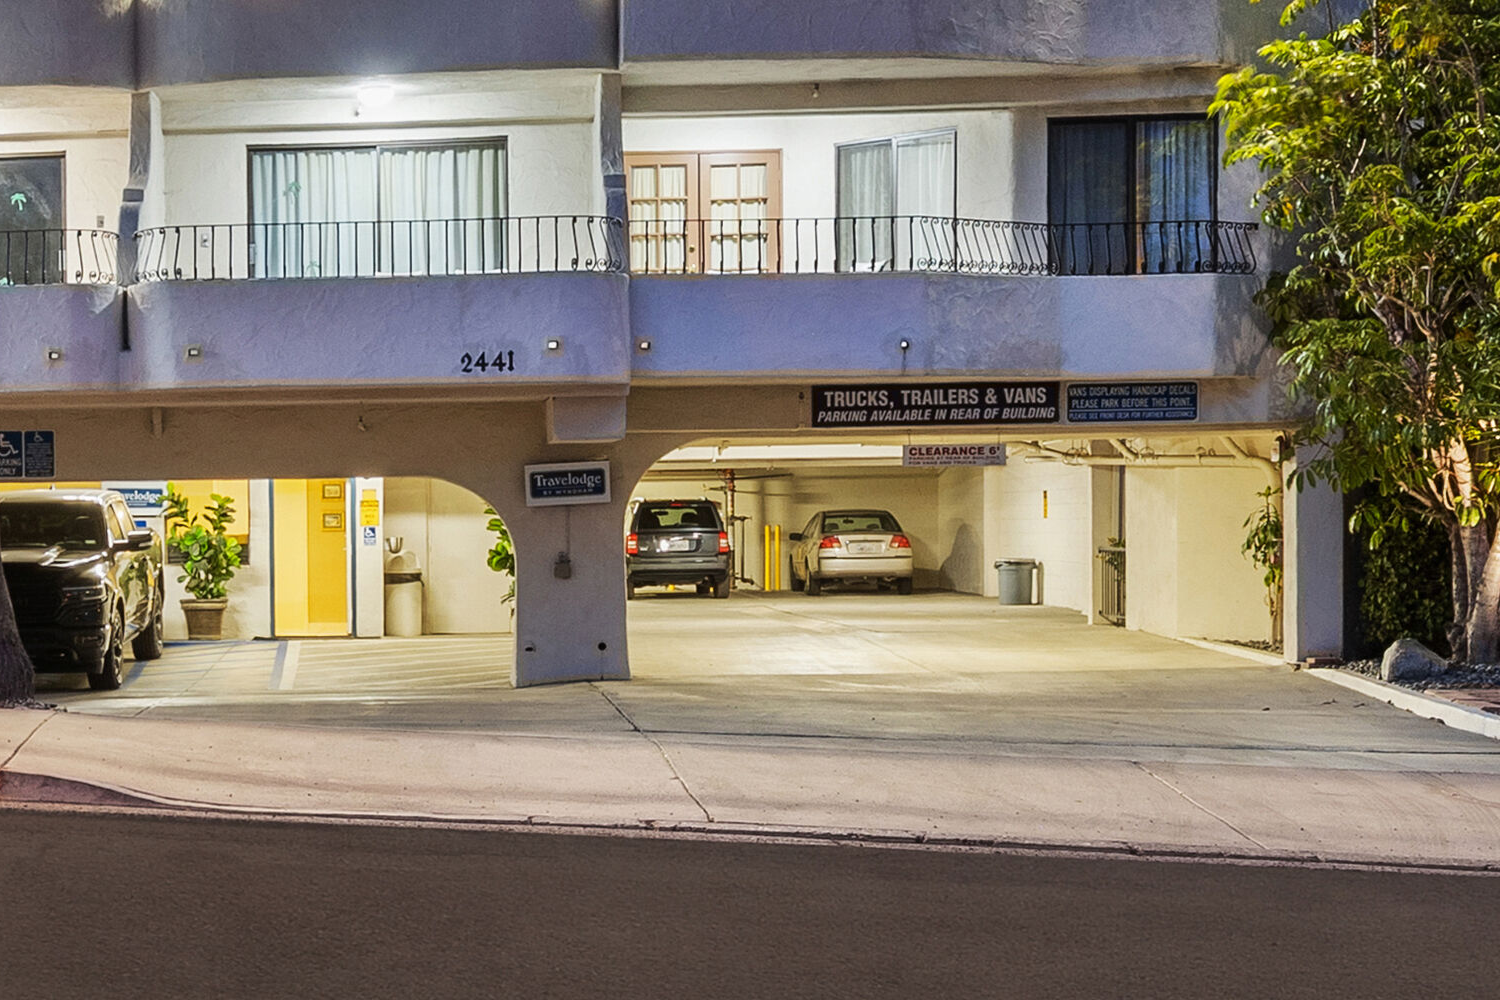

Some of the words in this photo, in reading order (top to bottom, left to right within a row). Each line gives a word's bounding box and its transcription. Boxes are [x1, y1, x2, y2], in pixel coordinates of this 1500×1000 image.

[461, 350, 514, 373] 2441
[824, 390, 894, 409] TRUCKS,
[901, 388, 979, 406] TRAILERS
[985, 388, 998, 405] &
[1004, 387, 1047, 404] VANS
[1069, 387, 1087, 396] VANS
[1089, 386, 1130, 396] DISPLAYING
[1132, 385, 1166, 395] HANDICAP
[1169, 385, 1196, 395] DECALS
[1071, 399, 1098, 408] PLEASE
[1101, 398, 1119, 408] PARK
[1121, 398, 1148, 407] BEFORE
[1152, 397, 1167, 407] THIS
[817, 409, 867, 422] PARKING
[870, 408, 931, 422] AVAILABLE
[935, 408, 947, 420] IN
[950, 407, 982, 420] REAR
[984, 407, 999, 419] OF
[1002, 406, 1056, 419] BUILDING
[909, 446, 985, 456] CLEARANCE
[533, 473, 601, 488] Travelodge
